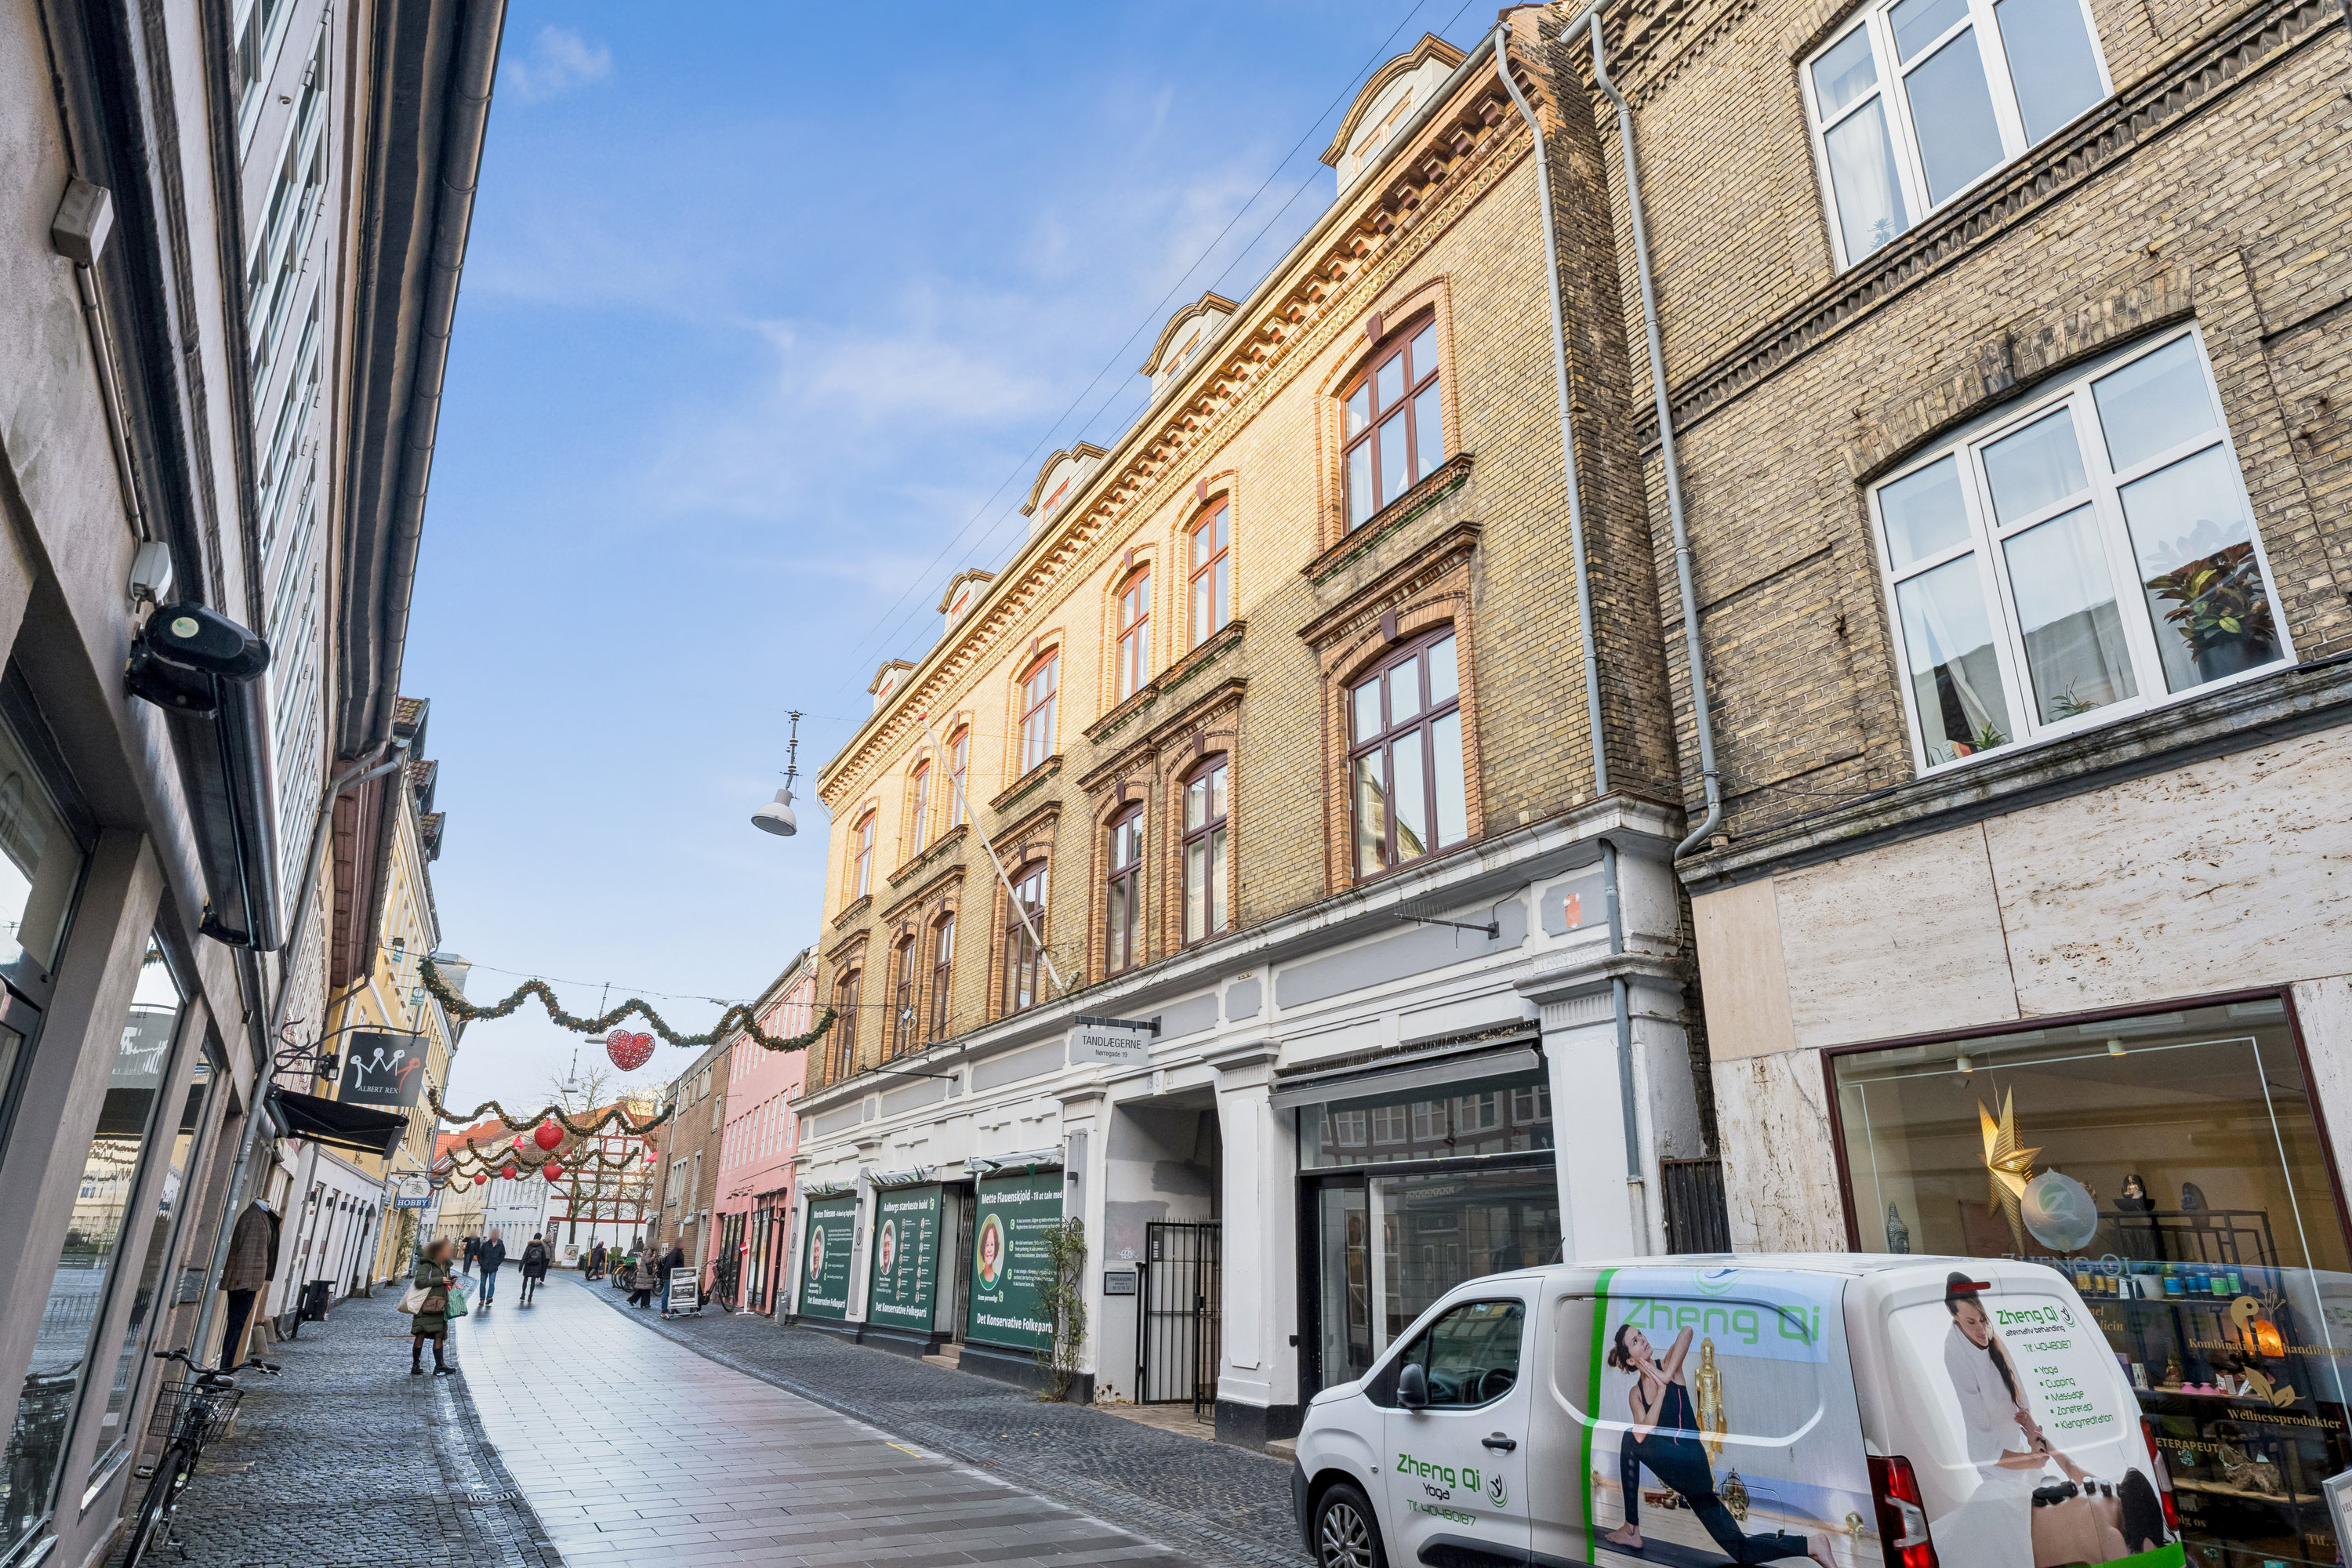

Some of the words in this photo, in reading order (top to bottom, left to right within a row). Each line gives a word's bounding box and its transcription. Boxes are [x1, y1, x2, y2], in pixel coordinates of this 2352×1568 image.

[1082, 1035, 1142, 1049] TANDLÆGERNE
[1146, 1077, 1153, 1090] 19
[1167, 1073, 1174, 1085] 21
[982, 1193, 996, 1204] Mette
[996, 1189, 1031, 1204] Flauenskjold
[1044, 1191, 1053, 1200] tale
[1053, 1189, 1063, 1199] med
[883, 1202, 899, 1214] Aalborgs
[899, 1200, 918, 1210] stærkeste
[918, 1199, 928, 1210] hold
[882, 1302, 906, 1315] Konservative
[906, 1305, 927, 1319] Folkeparti
[1996, 1308, 2045, 1325] Zheng
[2042, 1305, 2059, 1322] Qi
[977, 1312, 986, 1324] Det
[986, 1314, 1022, 1330] Konservative
[1022, 1318, 1053, 1335] Folkeparti
[1623, 1298, 1759, 1345] Zheng
[1777, 1305, 1820, 1346] Qi
[2005, 1327, 2034, 1337] alternativ
[2034, 1325, 2066, 1334] behandling
[2038, 1366, 2059, 1375] Yoga
[2045, 1377, 2076, 1388] Cupping
[2050, 1390, 2084, 1402] Massage
[2056, 1402, 2093, 1416] Zoneterapi
[2060, 1414, 2114, 1429] Klangmeditation
[2227, 1409, 2341, 1429] Wellnessprodukter
[2155, 1437, 2219, 1453] ETERAPEUT
[1396, 1454, 1456, 1489] Zheng
[1462, 1468, 1481, 1492] Qi
[1422, 1483, 1450, 1501] Yoga
[1406, 1499, 1421, 1513] Tlf.
[1421, 1503, 1476, 1526] 40480187
